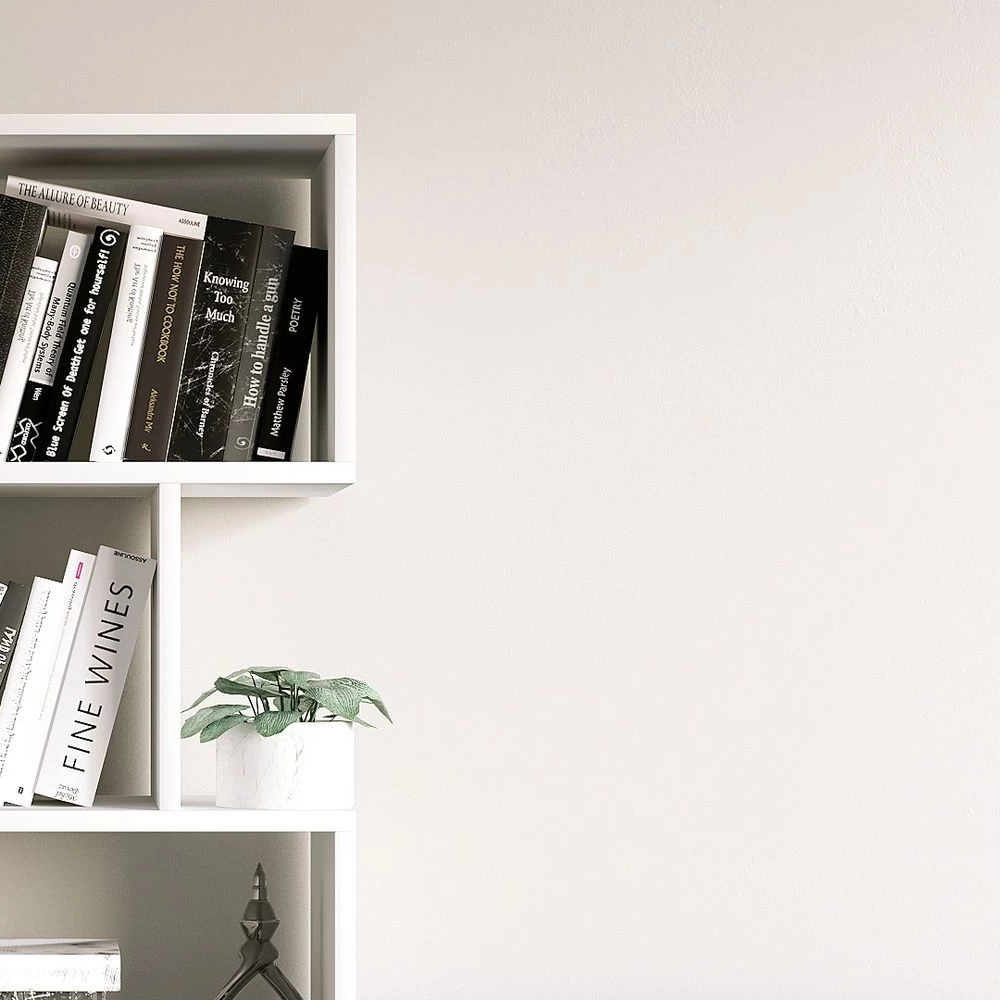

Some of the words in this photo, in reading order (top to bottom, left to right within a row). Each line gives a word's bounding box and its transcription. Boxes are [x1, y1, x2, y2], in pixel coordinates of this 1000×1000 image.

[18, 182, 38, 197] THE
[37, 186, 76, 206] ALLURE
[76, 194, 92, 208] OF
[91, 198, 130, 216] BEAUTY
[174, 244, 185, 260] THE
[170, 260, 182, 282] HOW
[203, 271, 250, 293] Knowing
[59, 281, 76, 318] Quantum
[167, 283, 178, 302] NOT
[214, 291, 234, 305] Too
[263, 276, 282, 303] gun
[41, 296, 61, 340] Many-Body
[83, 297, 97, 315] for
[164, 302, 175, 314] TO
[205, 308, 235, 323] Much
[263, 303, 273, 312] a
[286, 297, 304, 332] POETRY
[55, 319, 66, 338] Field
[79, 317, 92, 335] one
[250, 313, 273, 359] handle
[73, 337, 86, 355] Get
[156, 315, 173, 363] COOKBOOK
[33, 341, 48, 373] Systems
[45, 338, 61, 366] Theory
[44, 367, 54, 377] of
[64, 353, 82, 382] Death
[201, 351, 221, 396] Chronicles
[249, 360, 263, 375] to
[61, 384, 73, 397] Of
[242, 376, 261, 407] How
[275, 366, 293, 396] Parsley
[145, 388, 158, 420] Aleksandra
[202, 396, 212, 407] of
[51, 399, 70, 432] Screen
[143, 421, 152, 433] Mir
[193, 407, 210, 437] Barney
[268, 397, 286, 436] Matthew
[20, 422, 32, 446] OXFORD
[45, 434, 60, 457] Blue
[62, 700, 102, 773] FINE
[84, 581, 134, 685] WINES
